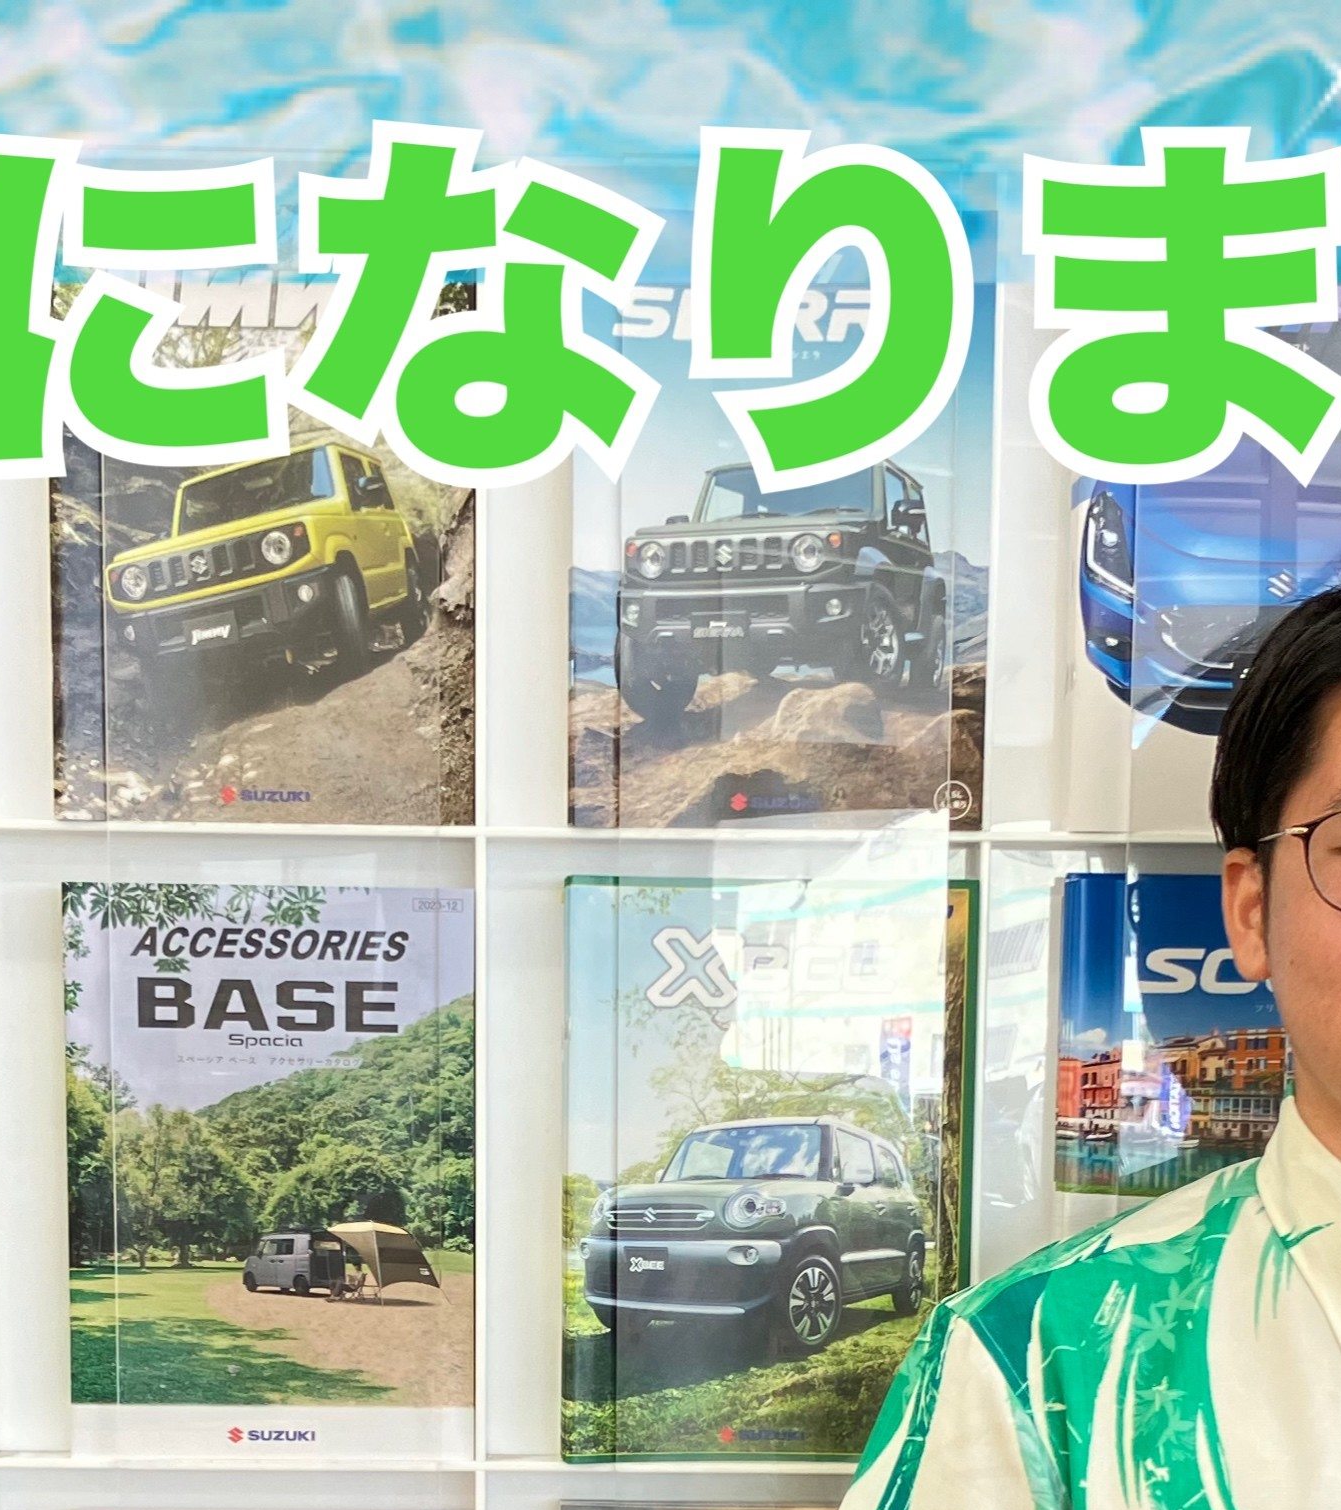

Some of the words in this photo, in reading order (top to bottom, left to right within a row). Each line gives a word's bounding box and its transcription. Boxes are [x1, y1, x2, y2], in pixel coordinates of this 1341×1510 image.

[240, 789, 311, 803] SUZUKI
[130, 925, 410, 963] ACCESSORIES
[136, 976, 400, 1035] BASE
[227, 1033, 304, 1050] Spacia
[246, 1429, 316, 1443] SUZUKI
